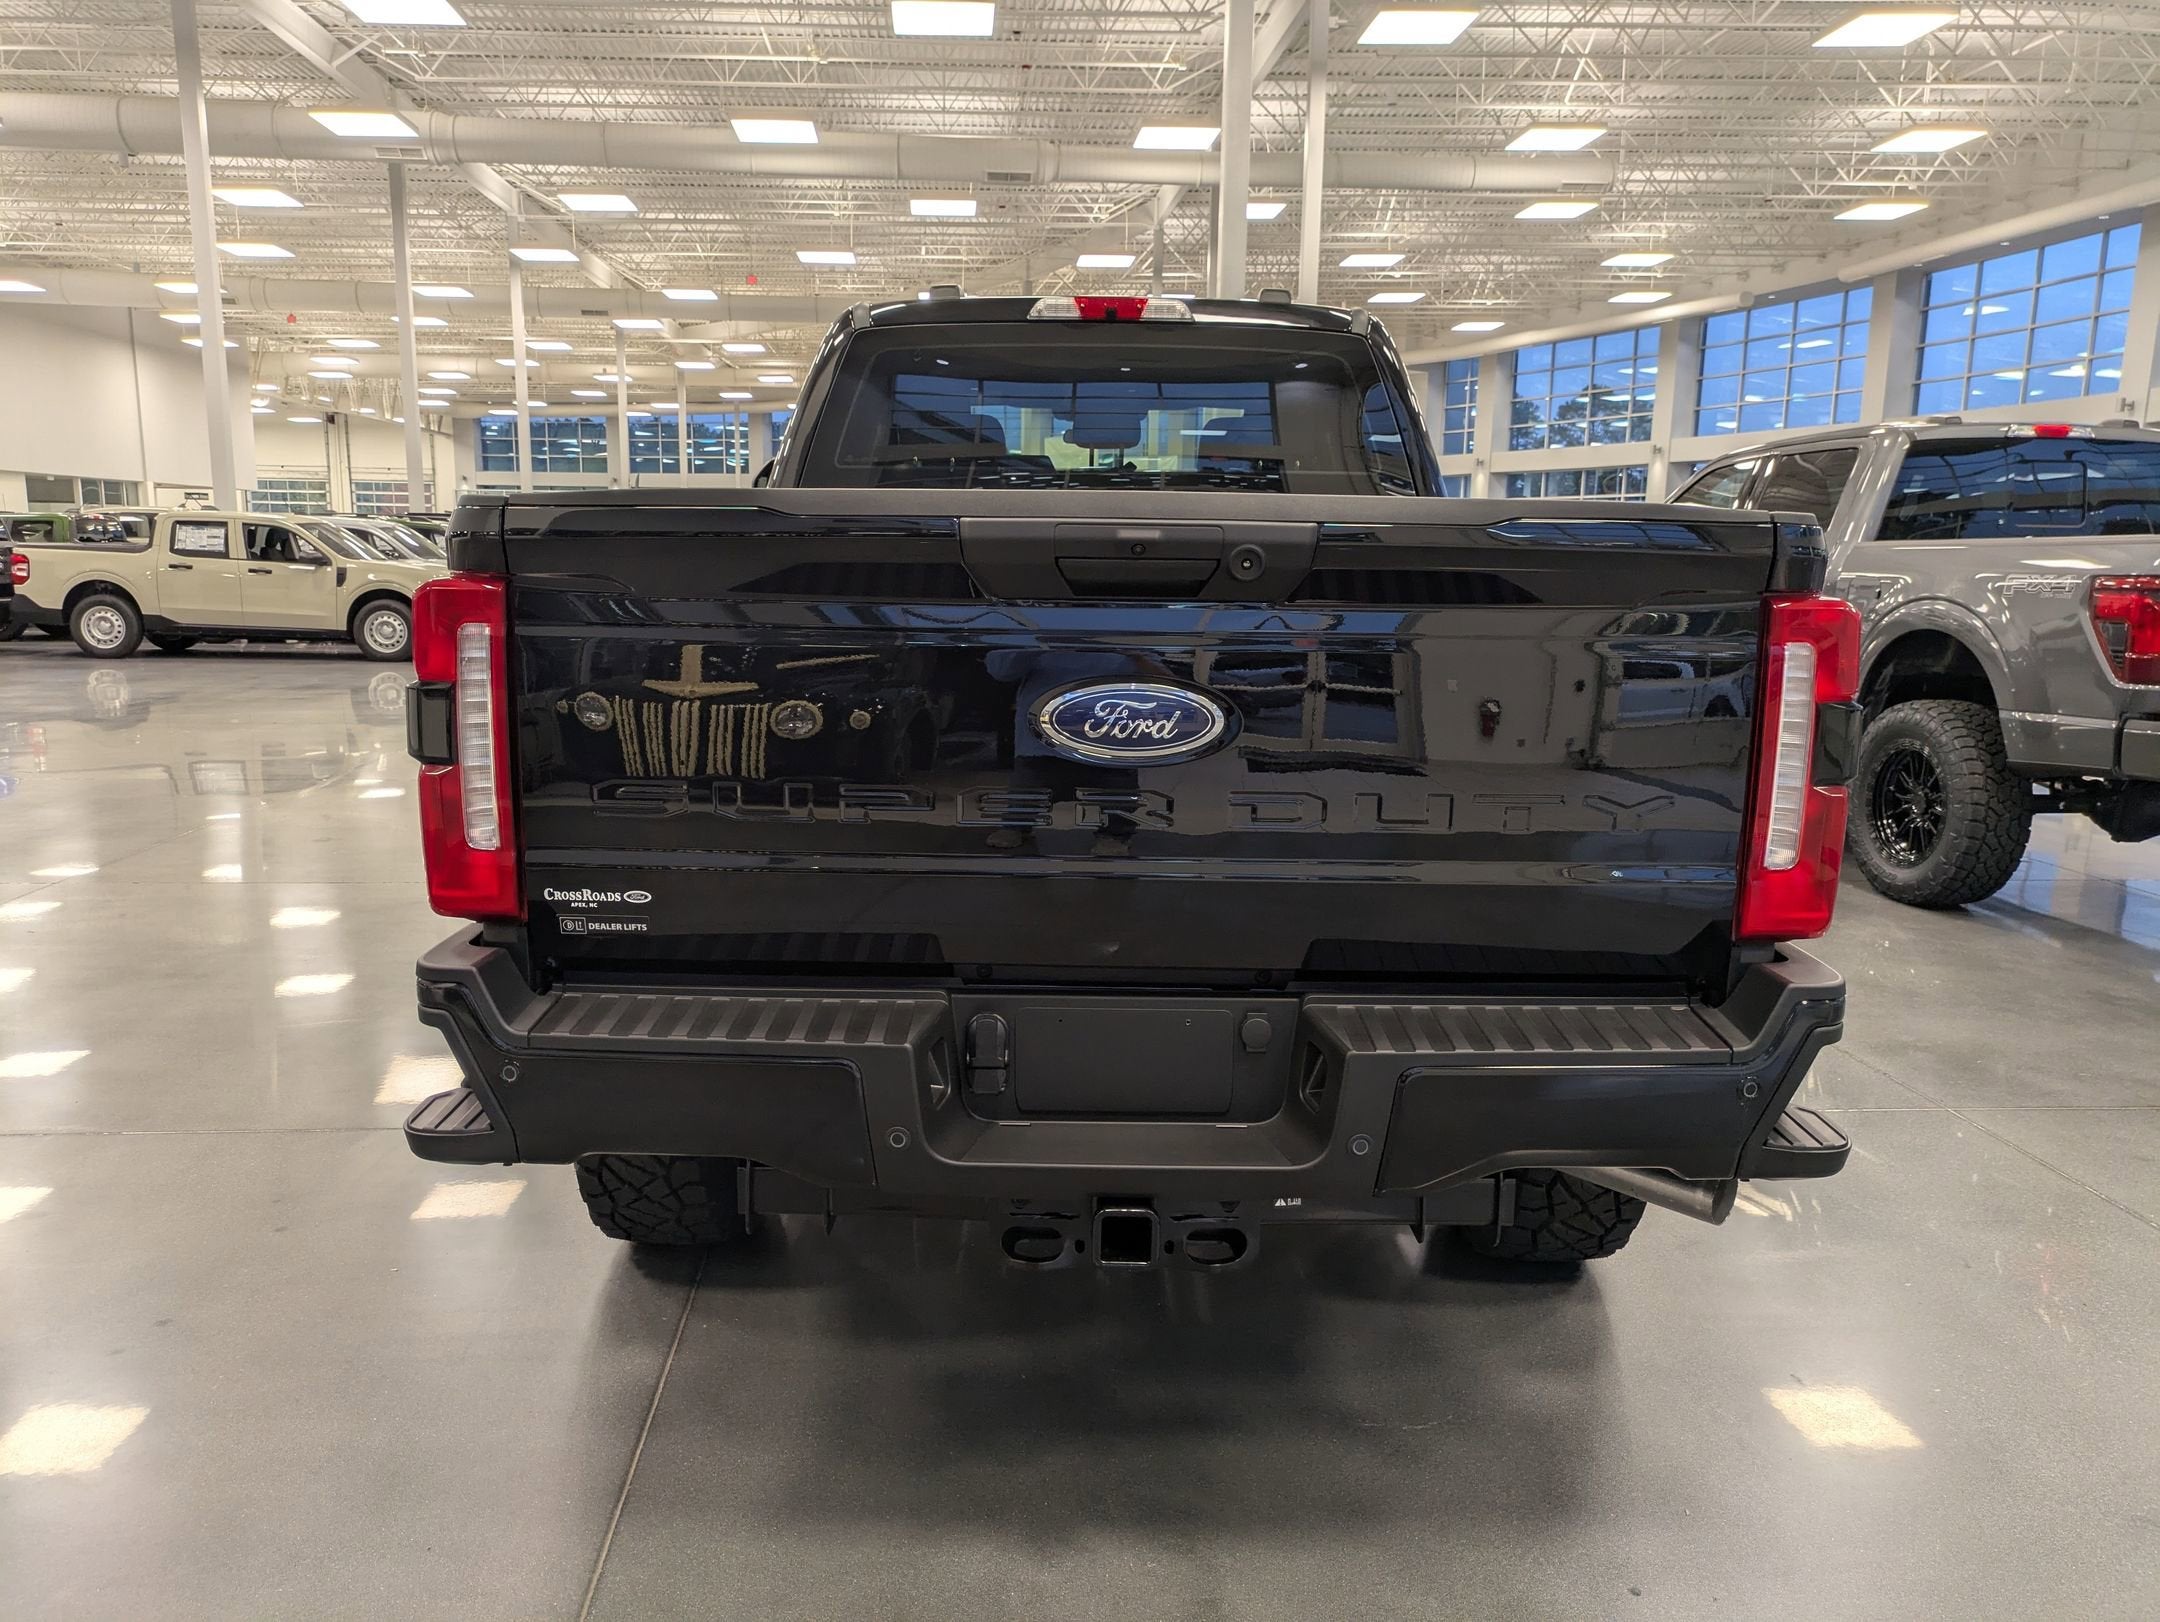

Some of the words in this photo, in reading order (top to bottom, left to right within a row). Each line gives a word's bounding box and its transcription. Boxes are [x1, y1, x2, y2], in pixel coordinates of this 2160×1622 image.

[2003, 574, 2077, 597] FX4
[1084, 699, 1182, 740] Ford
[1228, 790, 1677, 833] DUTY
[588, 922, 622, 931] DEALER
[623, 923, 648, 932] LIFTS
